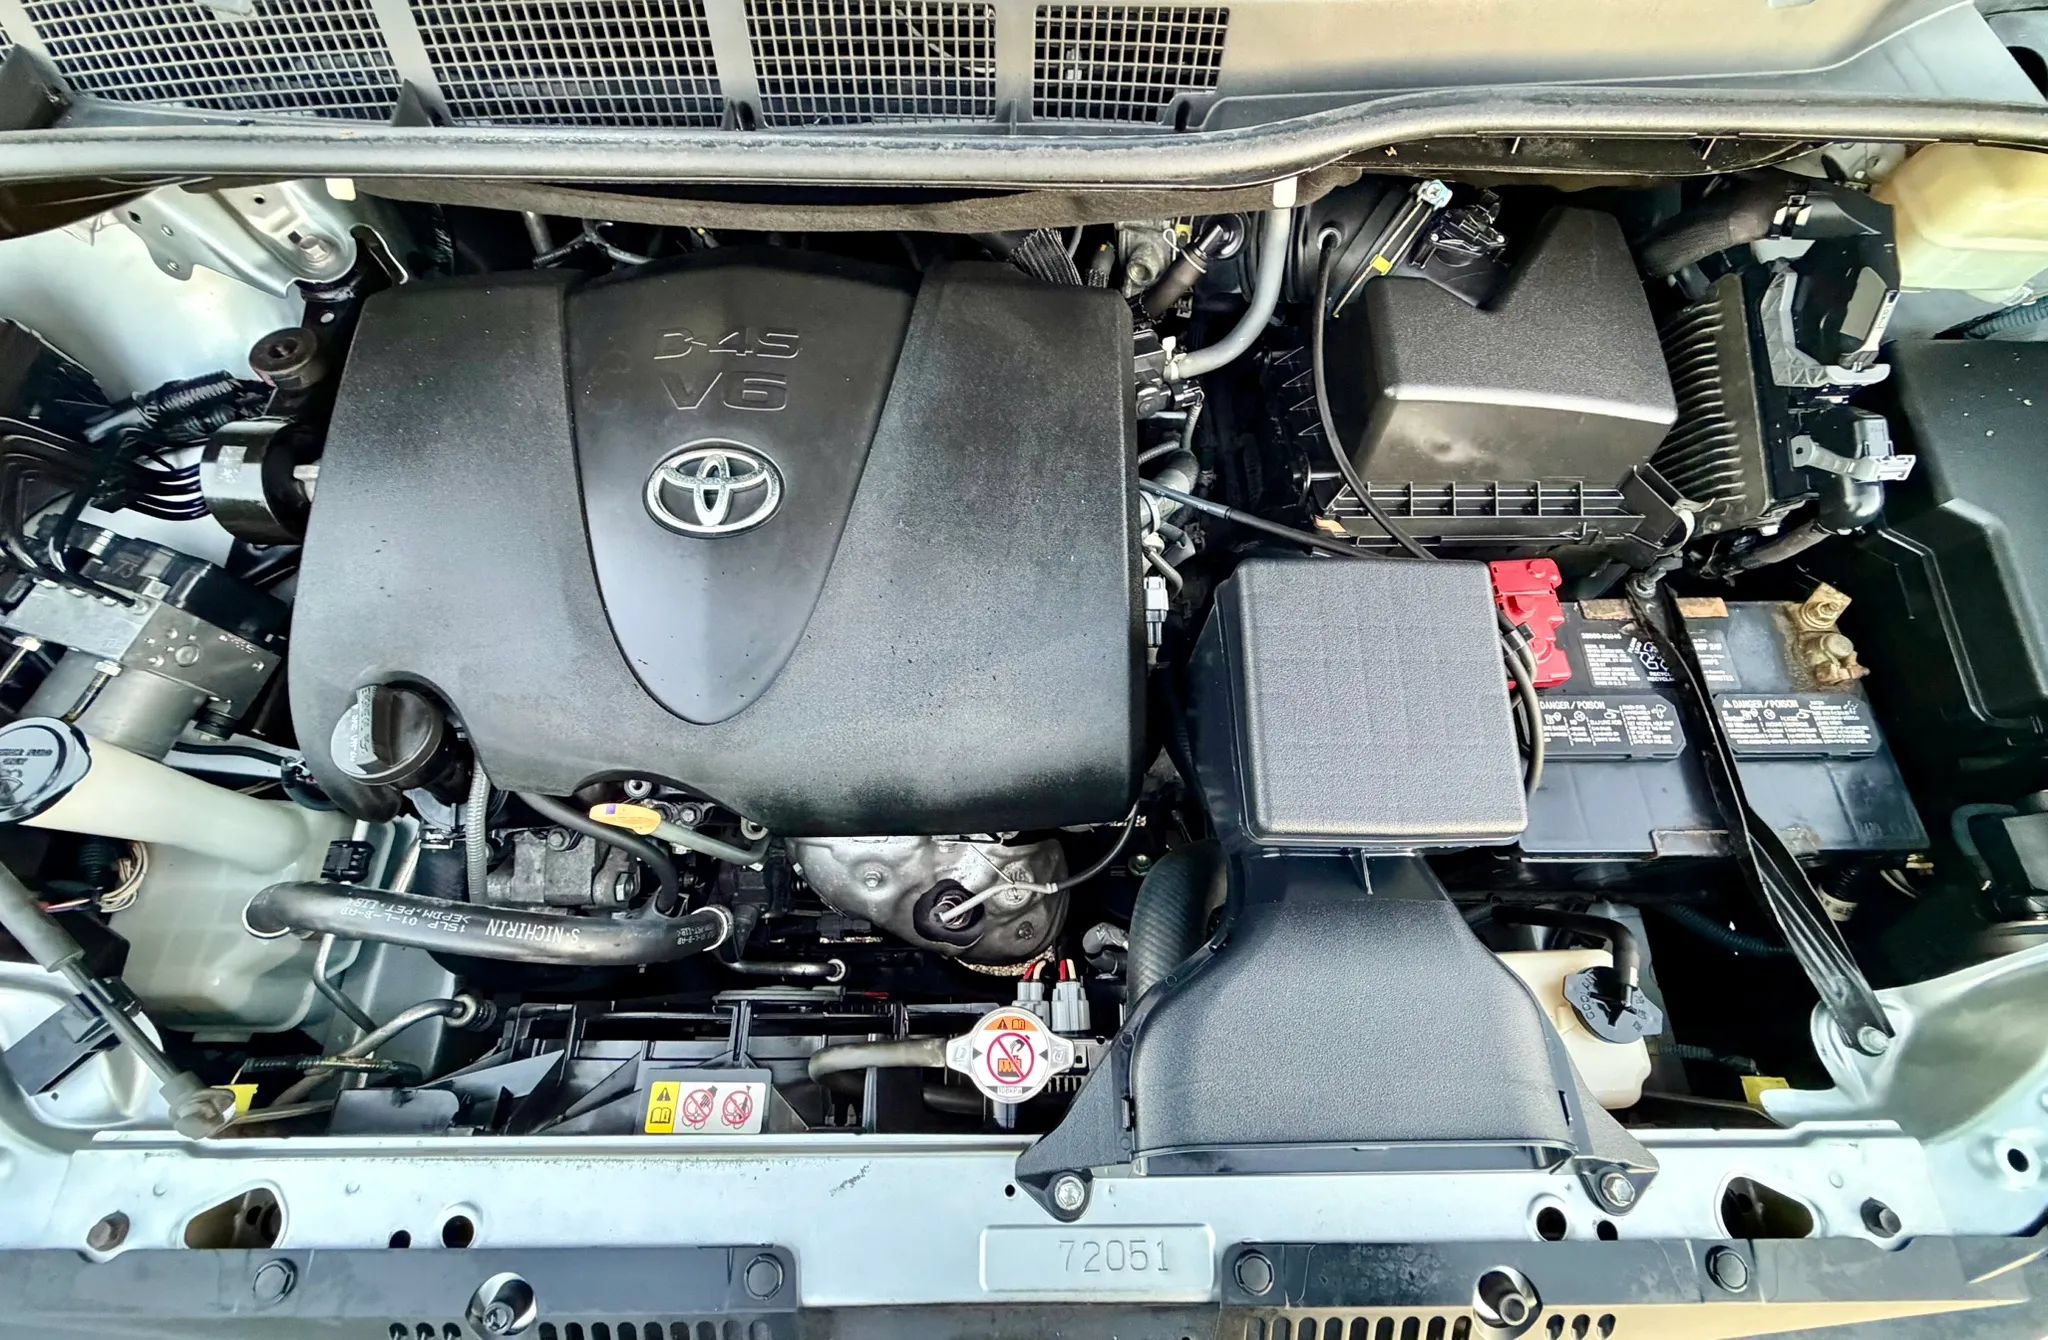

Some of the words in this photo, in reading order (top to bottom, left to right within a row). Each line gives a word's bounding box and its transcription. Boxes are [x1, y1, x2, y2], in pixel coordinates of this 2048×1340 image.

[659, 370, 789, 412] V6
[1539, 700, 1570, 710] DANGER
[1576, 700, 1606, 710] POISON
[1731, 699, 1764, 709] DANGER
[1769, 699, 1800, 709] POISON
[1058, 1239, 1169, 1272] 72051
